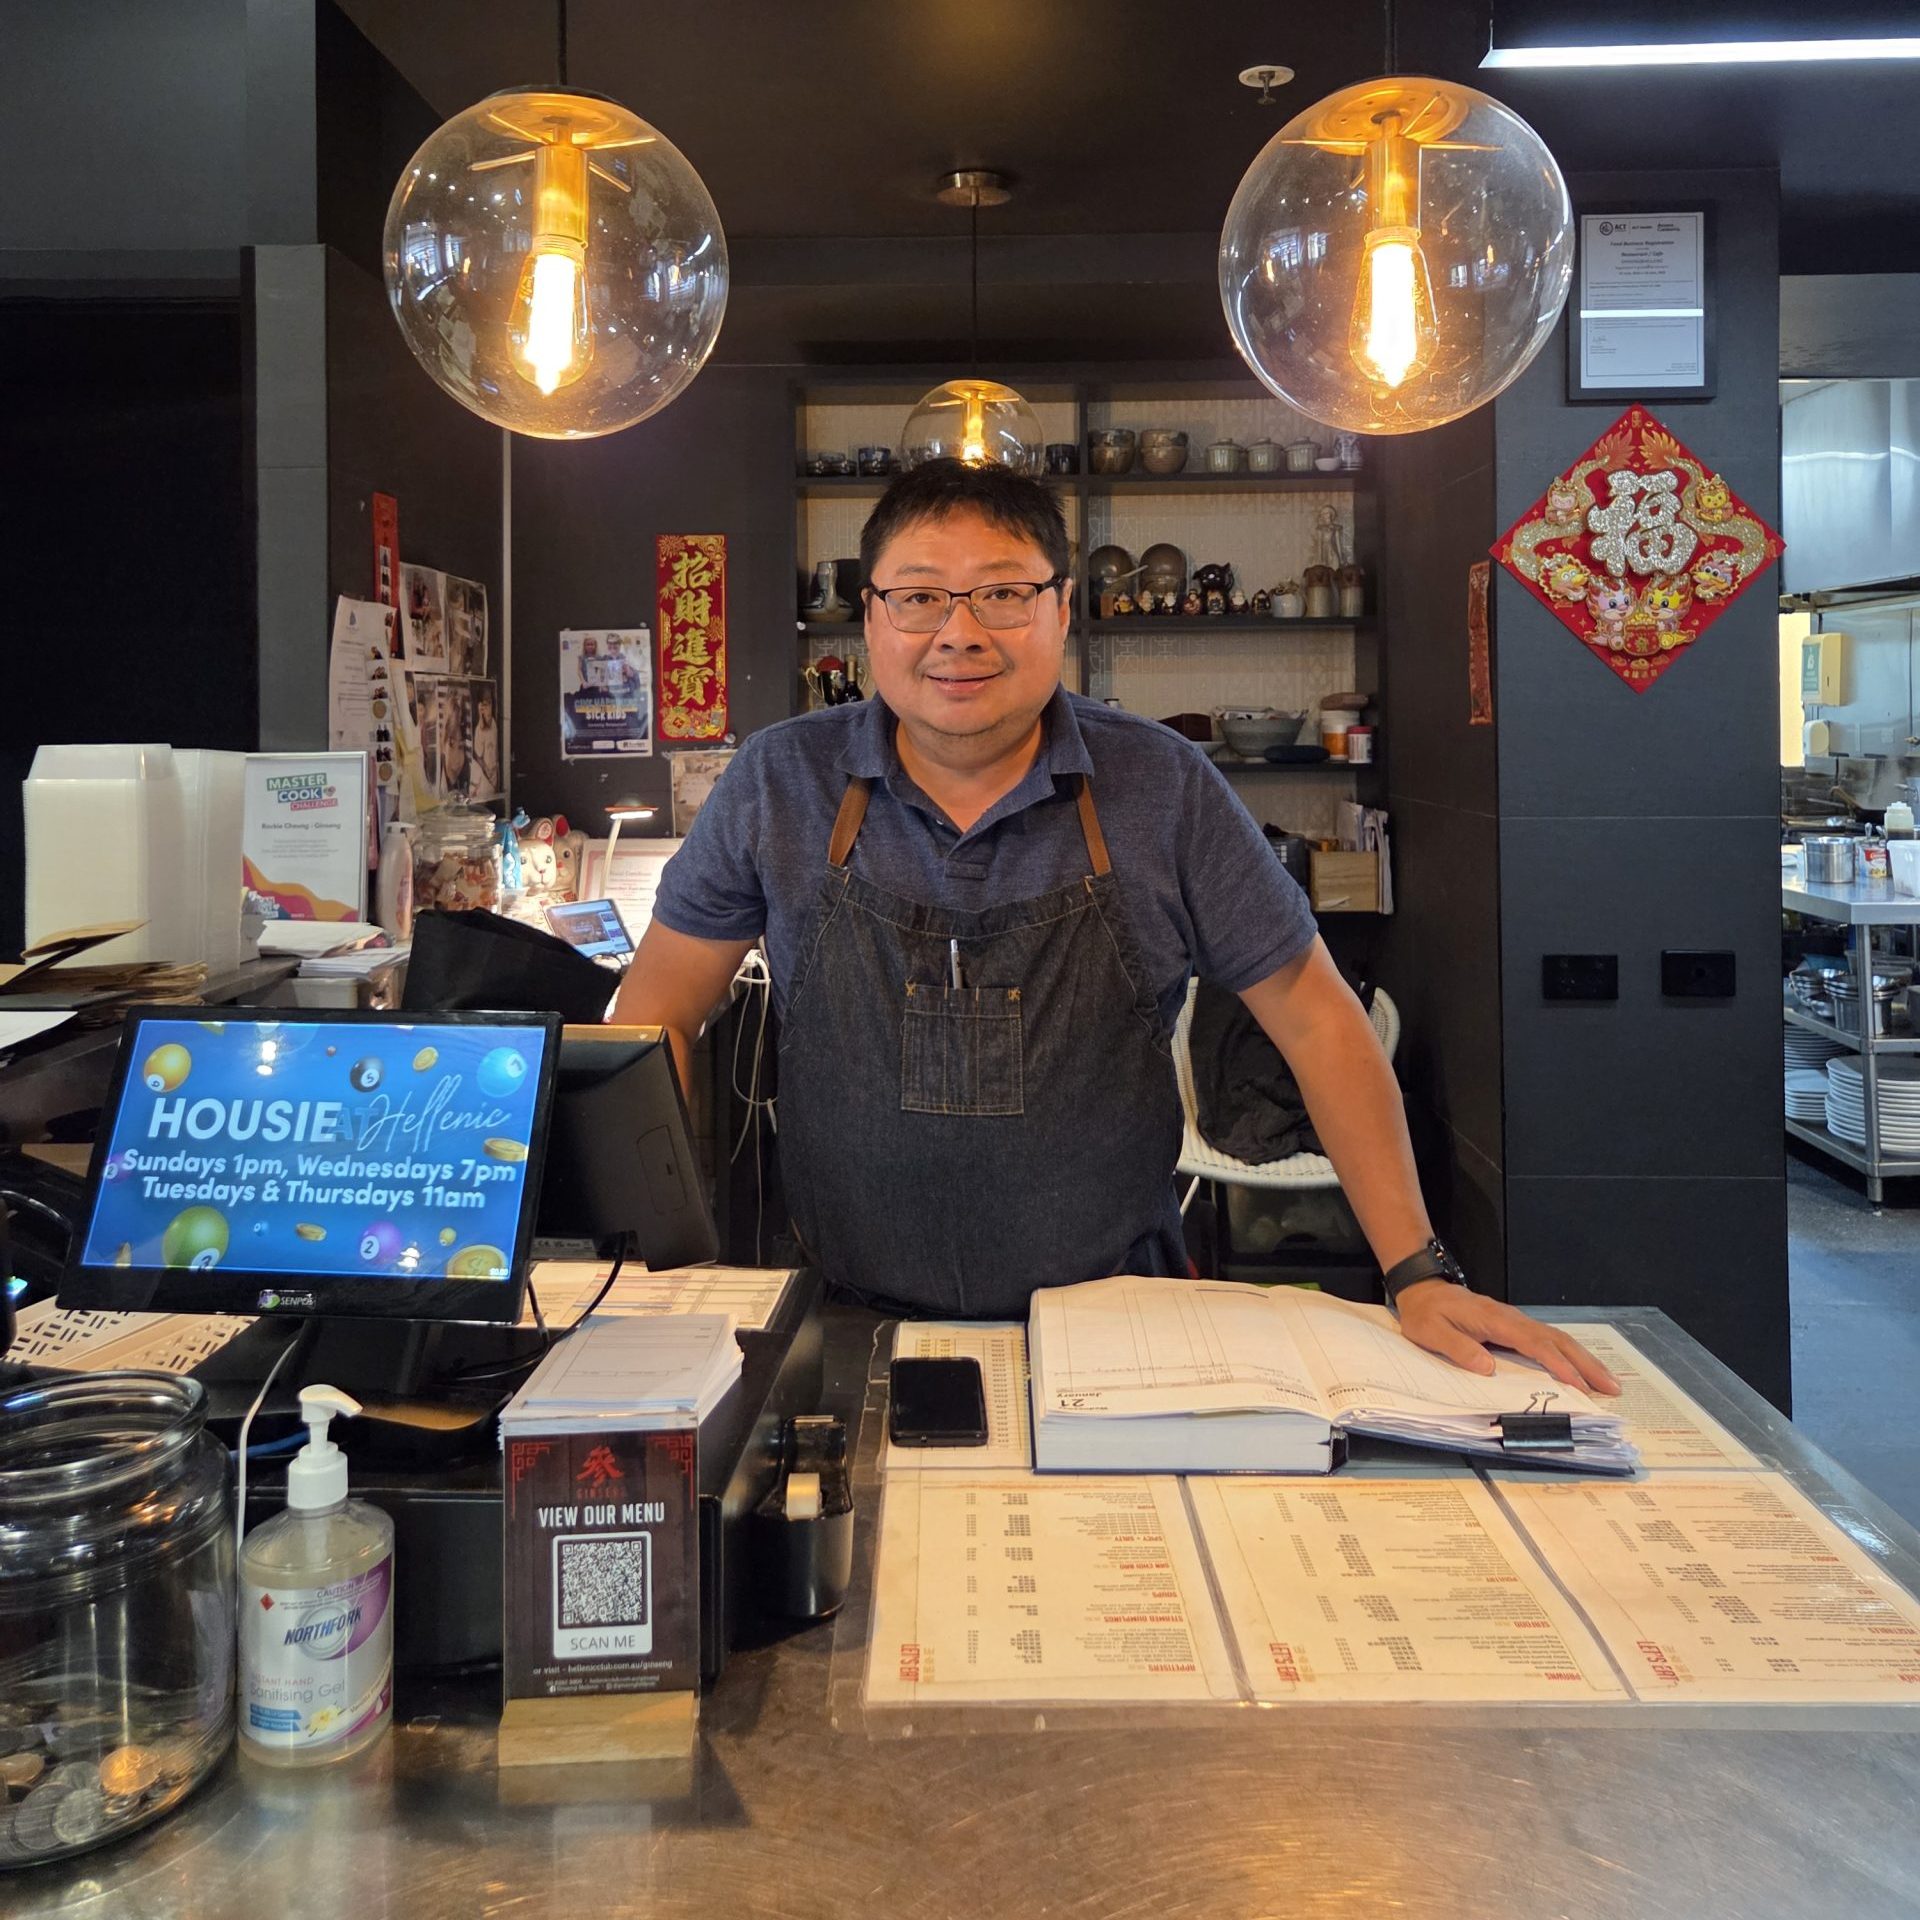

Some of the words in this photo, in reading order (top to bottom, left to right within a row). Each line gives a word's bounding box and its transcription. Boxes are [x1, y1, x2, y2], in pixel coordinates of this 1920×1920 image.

[1587, 470, 1698, 577] 福
[671, 550, 715, 707] 招財進寶
[607, 710, 627, 720] KIDS
[268, 774, 326, 790] MASTER
[279, 788, 320, 802] COOK
[291, 799, 337, 811] CHALLENGE
[147, 1097, 343, 1144] HOUSIE
[356, 1074, 512, 1153] Hellenic
[121, 1148, 226, 1175] Sundays
[233, 1153, 289, 1178] 1pm,
[297, 1154, 454, 1185] Wednesdays
[459, 1158, 516, 1184] 7pm
[142, 1176, 256, 1206] Tuesdays
[261, 1182, 281, 1202] &
[285, 1182, 414, 1212] Thursdays
[422, 1186, 486, 1208] 11am
[363, 1241, 374, 1254] 2
[1057, 1391, 1102, 1399] January
[1061, 1399, 1085, 1407] 21
[538, 1507, 578, 1528] VIEW
[584, 1505, 616, 1525] OUR
[622, 1502, 665, 1524] MENU
[317, 1581, 354, 1599] CAUTION
[283, 1606, 363, 1646] NORTHFORK
[570, 1636, 609, 1651] SCAN
[614, 1635, 636, 1648] ME
[544, 1666, 560, 1675] visit
[285, 1676, 314, 1686] HAND
[249, 1682, 313, 1703] Sanitising
[318, 1679, 345, 1697] Gel
